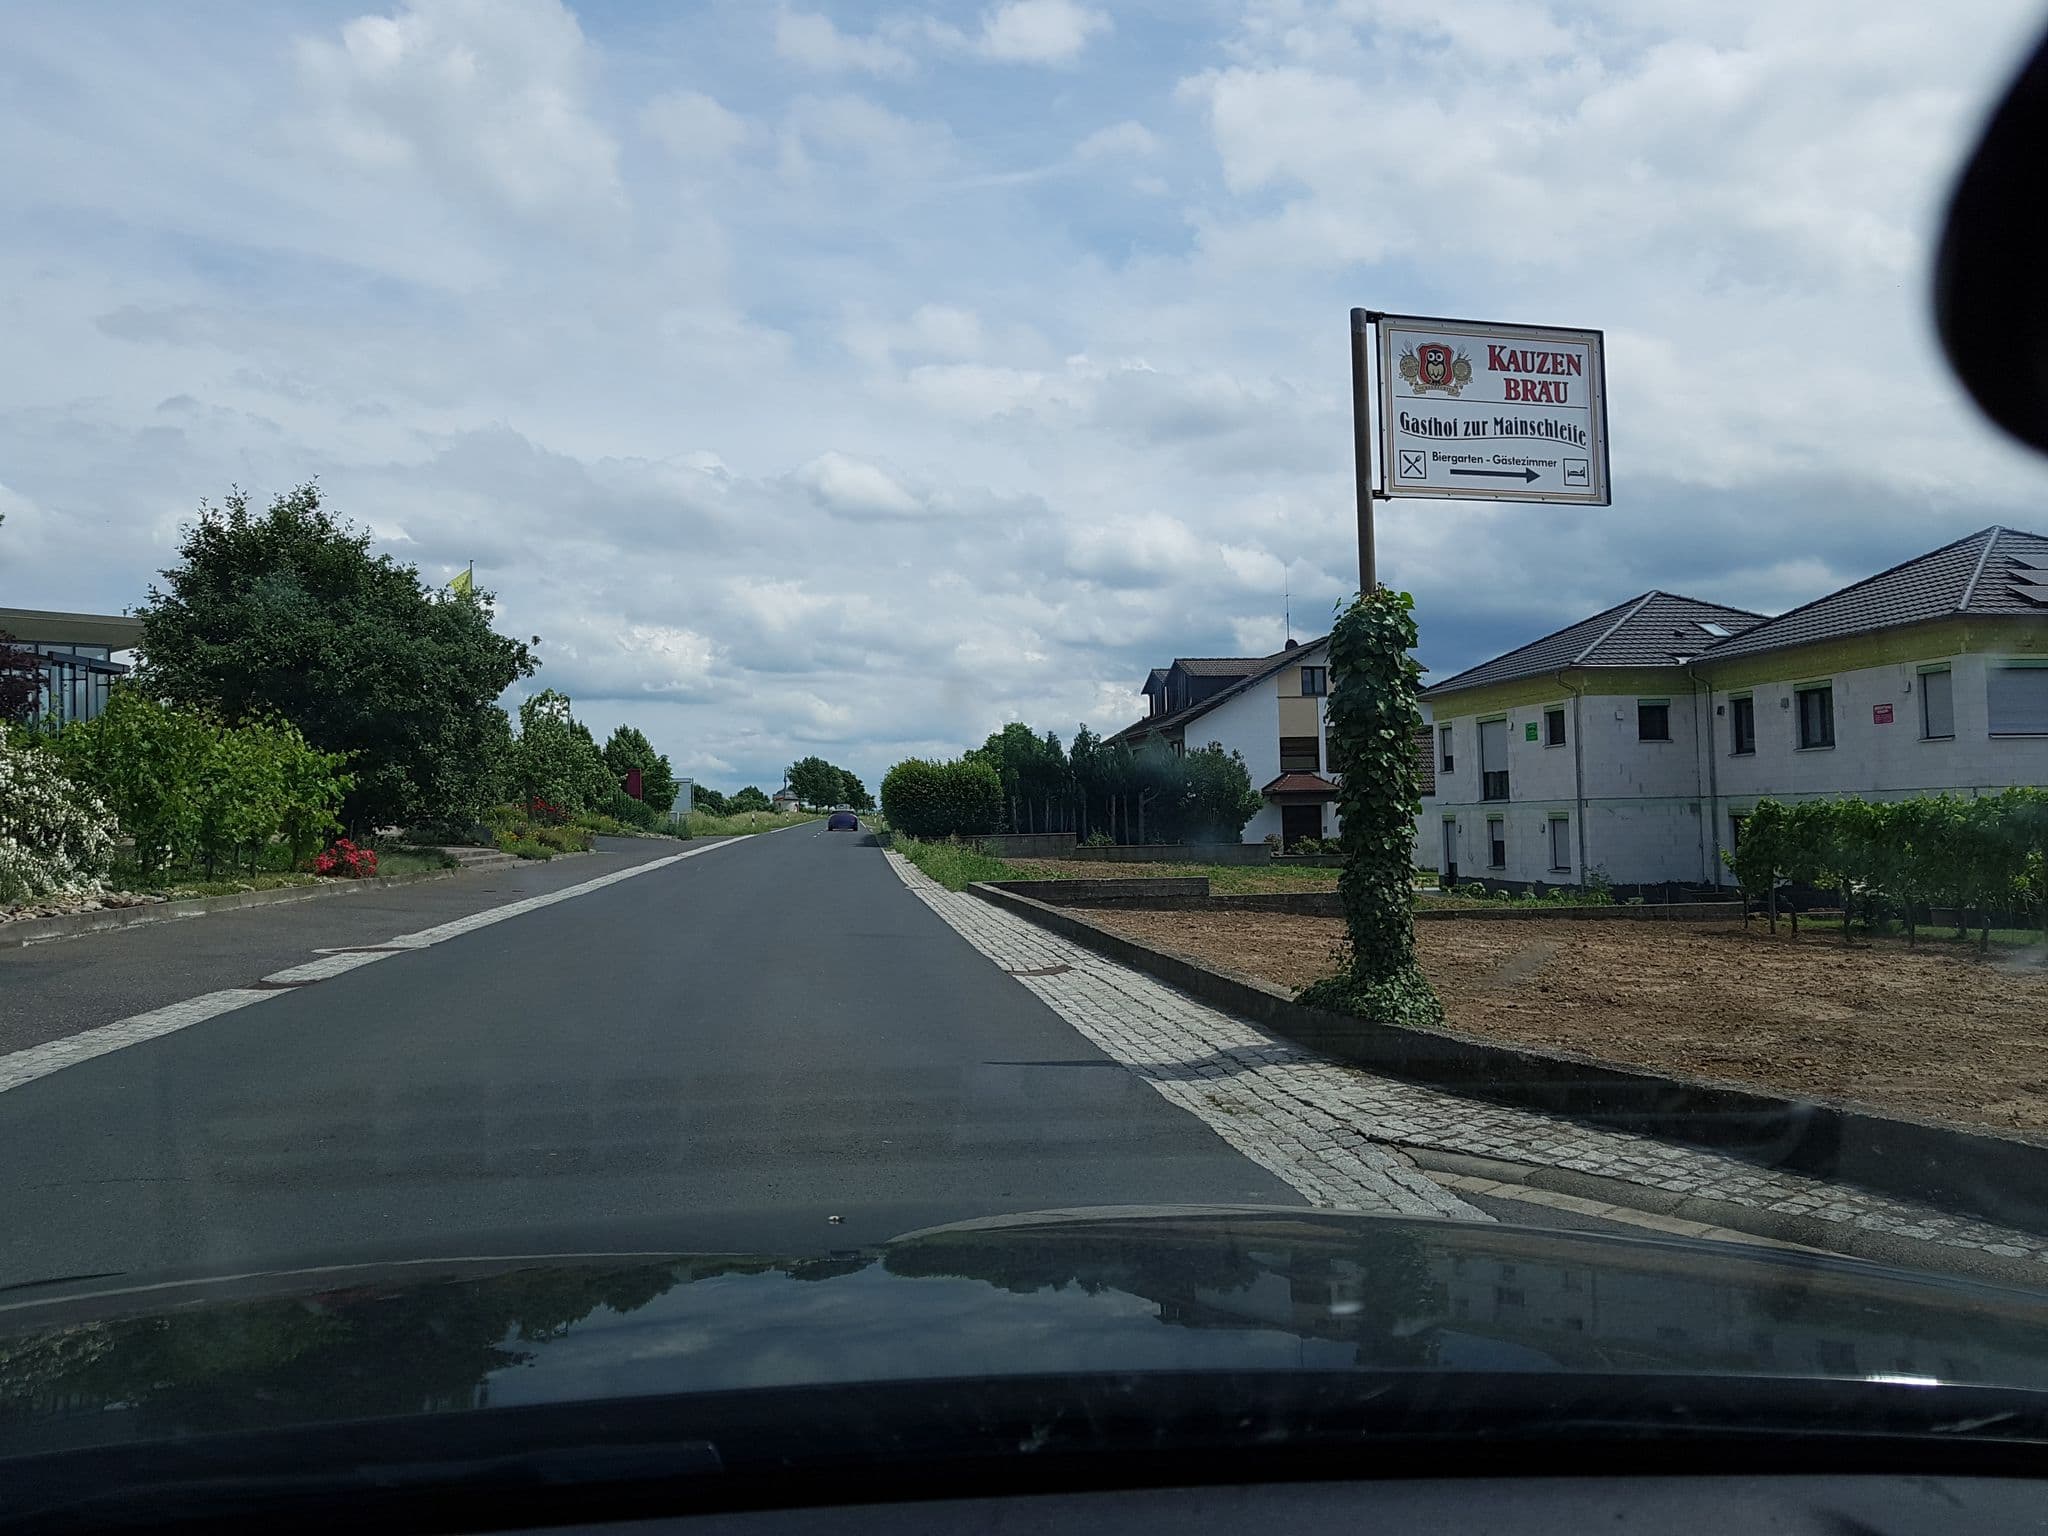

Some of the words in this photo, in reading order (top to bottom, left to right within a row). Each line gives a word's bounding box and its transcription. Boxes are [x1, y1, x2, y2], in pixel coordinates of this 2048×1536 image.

[1487, 344, 1582, 377] KAUZEN
[1503, 378, 1569, 403] BRÄU
[1400, 411, 1458, 437] Gasthof
[1463, 420, 1489, 436] zur
[1493, 417, 1587, 446] Mainschleife
[1432, 451, 1484, 465] Biergarten
[1492, 454, 1557, 468] Gästezimmer
